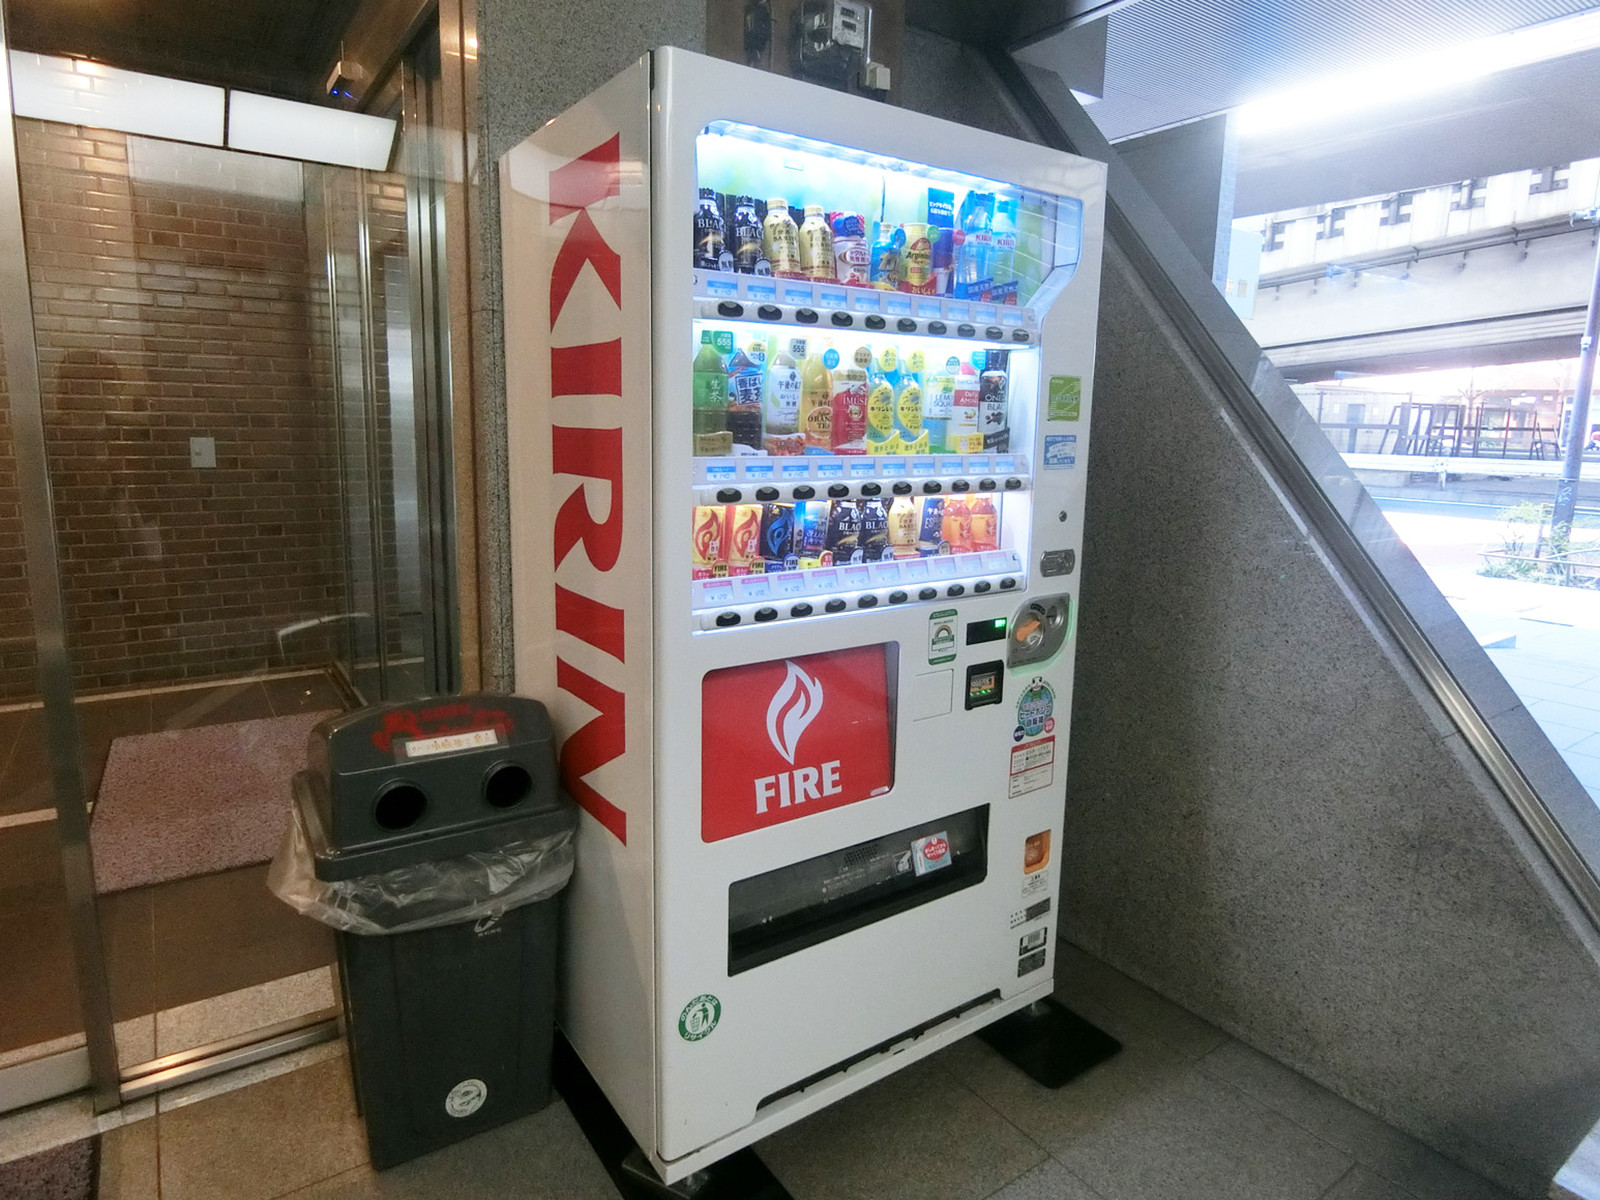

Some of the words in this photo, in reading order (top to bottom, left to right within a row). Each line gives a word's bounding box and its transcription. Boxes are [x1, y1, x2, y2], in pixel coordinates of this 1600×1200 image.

[792, 345, 805, 353] 555
[549, 132, 627, 847] KIRIN
[714, 564, 728, 572] FIRE
[751, 562, 764, 570] FIRE
[754, 760, 843, 815] FIRE
